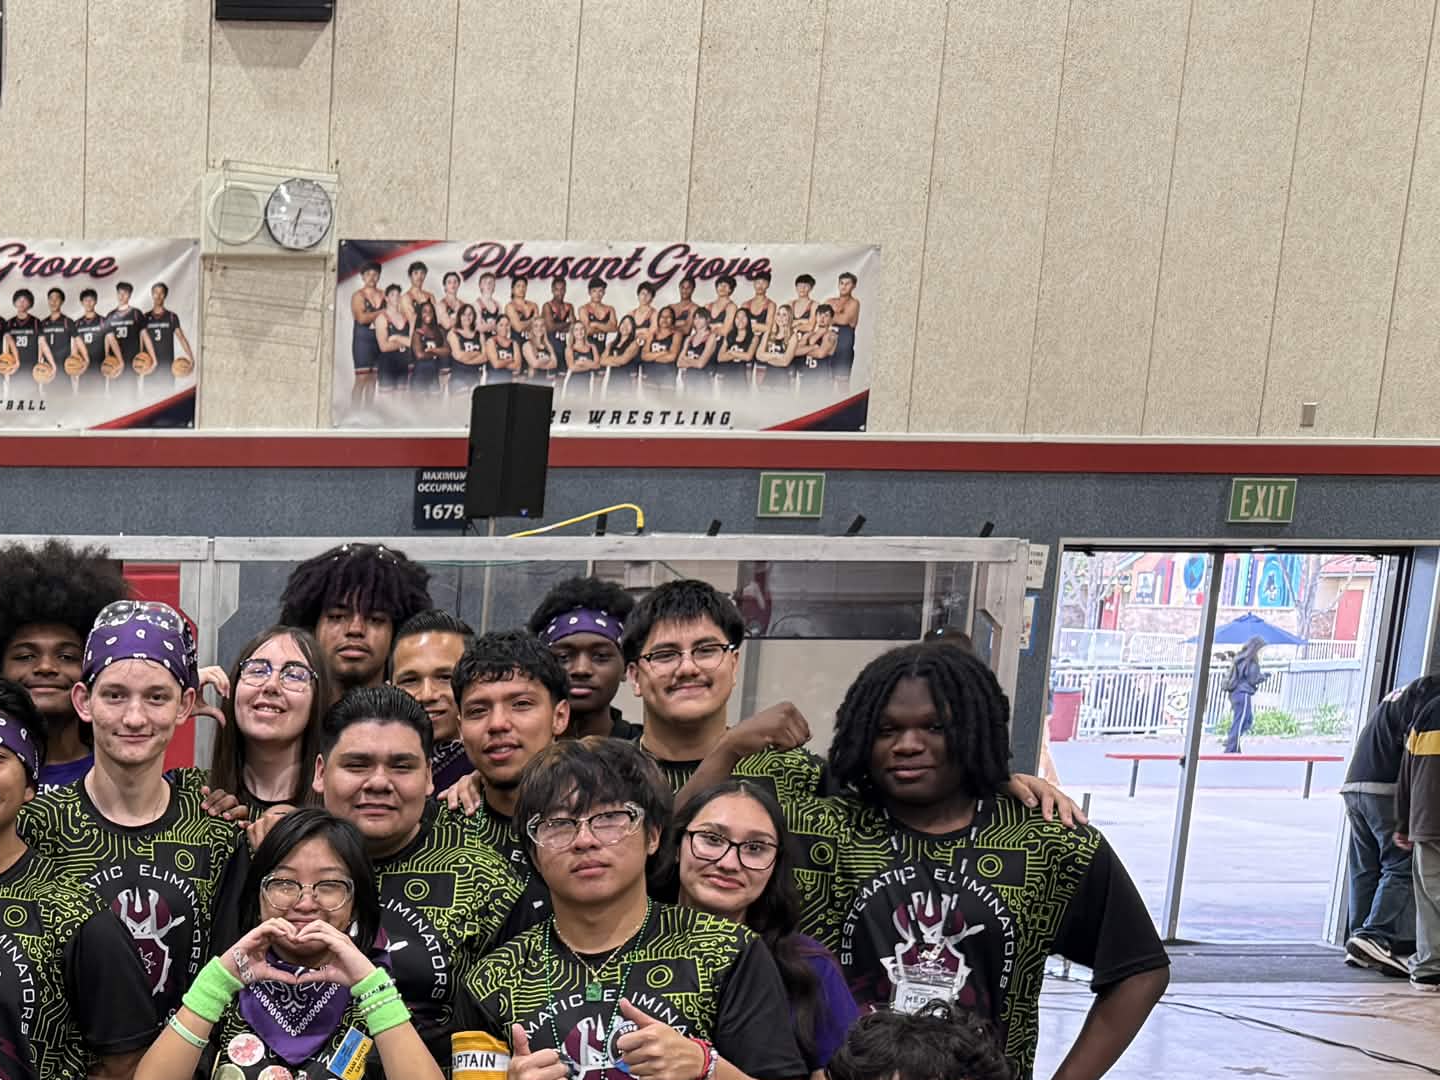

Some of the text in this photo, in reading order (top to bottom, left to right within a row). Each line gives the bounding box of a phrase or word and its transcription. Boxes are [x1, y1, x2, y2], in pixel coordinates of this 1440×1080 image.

[460, 241, 772, 292] Pleasant Grove
[588, 410, 732, 426] WRESTLING
[422, 471, 468, 481] MAXIMUM
[423, 503, 465, 520] 1679
[769, 479, 817, 512] EXIT
[1240, 485, 1289, 517] EXIT
[139, 864, 201, 975] ELIMINATORS
[934, 867, 1015, 989] ELIMINATORS
